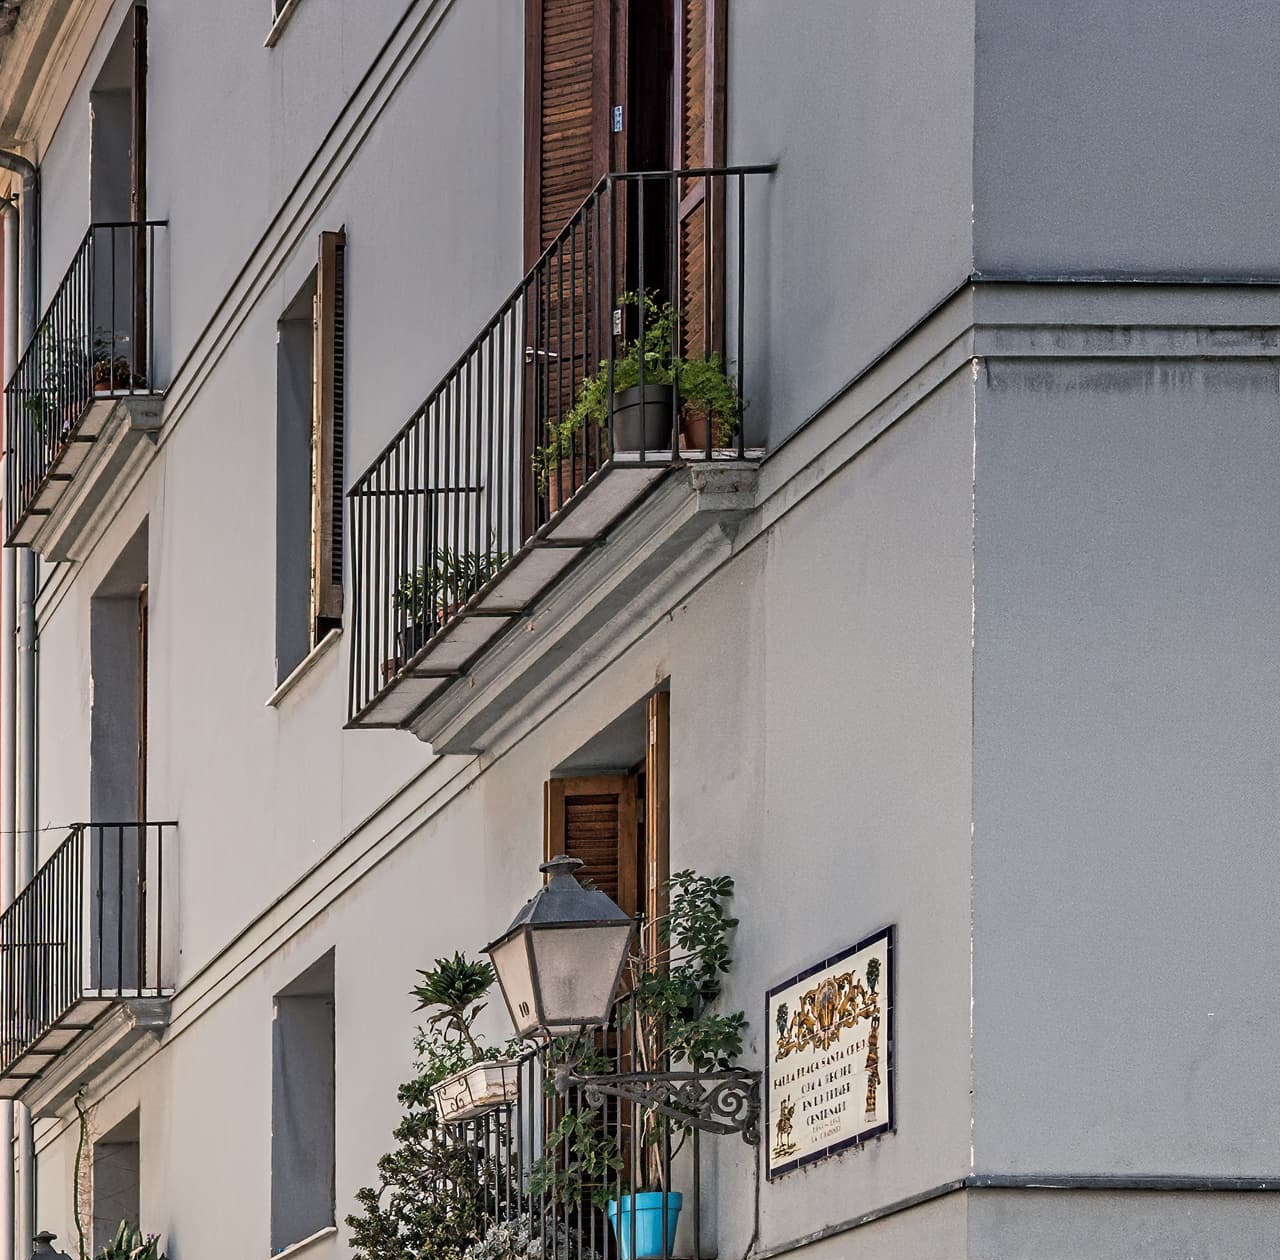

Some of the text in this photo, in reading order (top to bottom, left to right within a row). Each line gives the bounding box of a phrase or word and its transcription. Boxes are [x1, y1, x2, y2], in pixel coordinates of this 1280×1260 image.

[519, 1001, 530, 1018] 10
[773, 1073, 796, 1090] FALLA
[821, 1051, 844, 1067] SANTA
[802, 1101, 812, 1112] EN
[806, 1101, 846, 1126] CENTENARI
